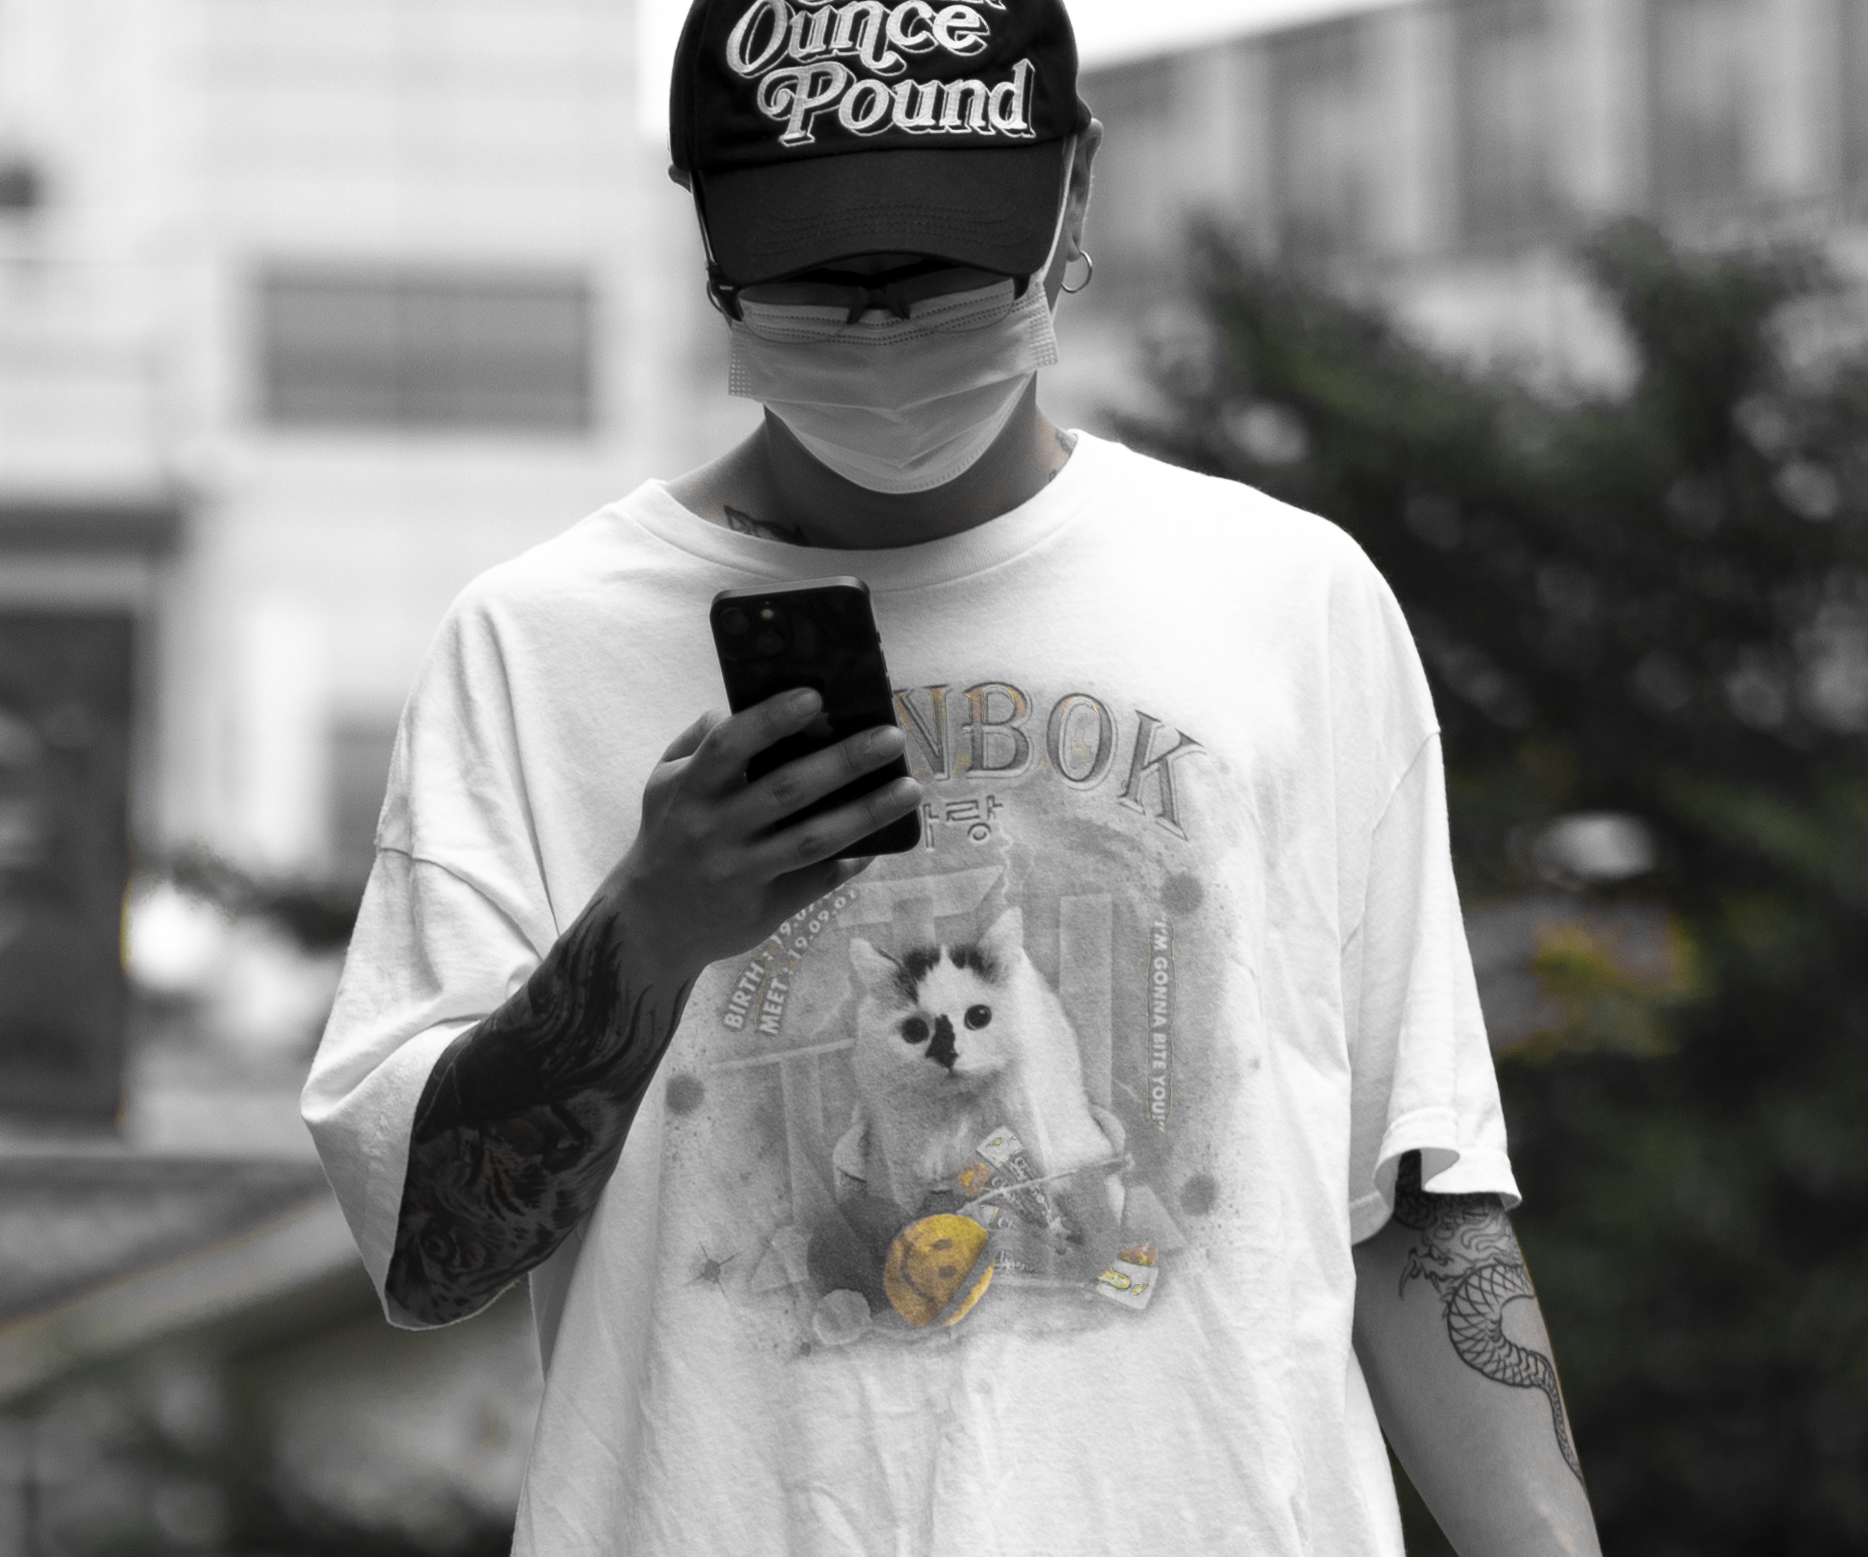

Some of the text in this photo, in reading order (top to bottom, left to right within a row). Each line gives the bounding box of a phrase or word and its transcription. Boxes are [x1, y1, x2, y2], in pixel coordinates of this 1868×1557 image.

[727, 0, 989, 77] Ounce
[757, 60, 1035, 147] Pound
[893, 680, 1208, 843] NBOK
[723, 962, 766, 1029] BIRTH
[758, 977, 789, 1035] MEET
[1153, 955, 1169, 1028] GONNA
[1152, 1032, 1167, 1070] BITE
